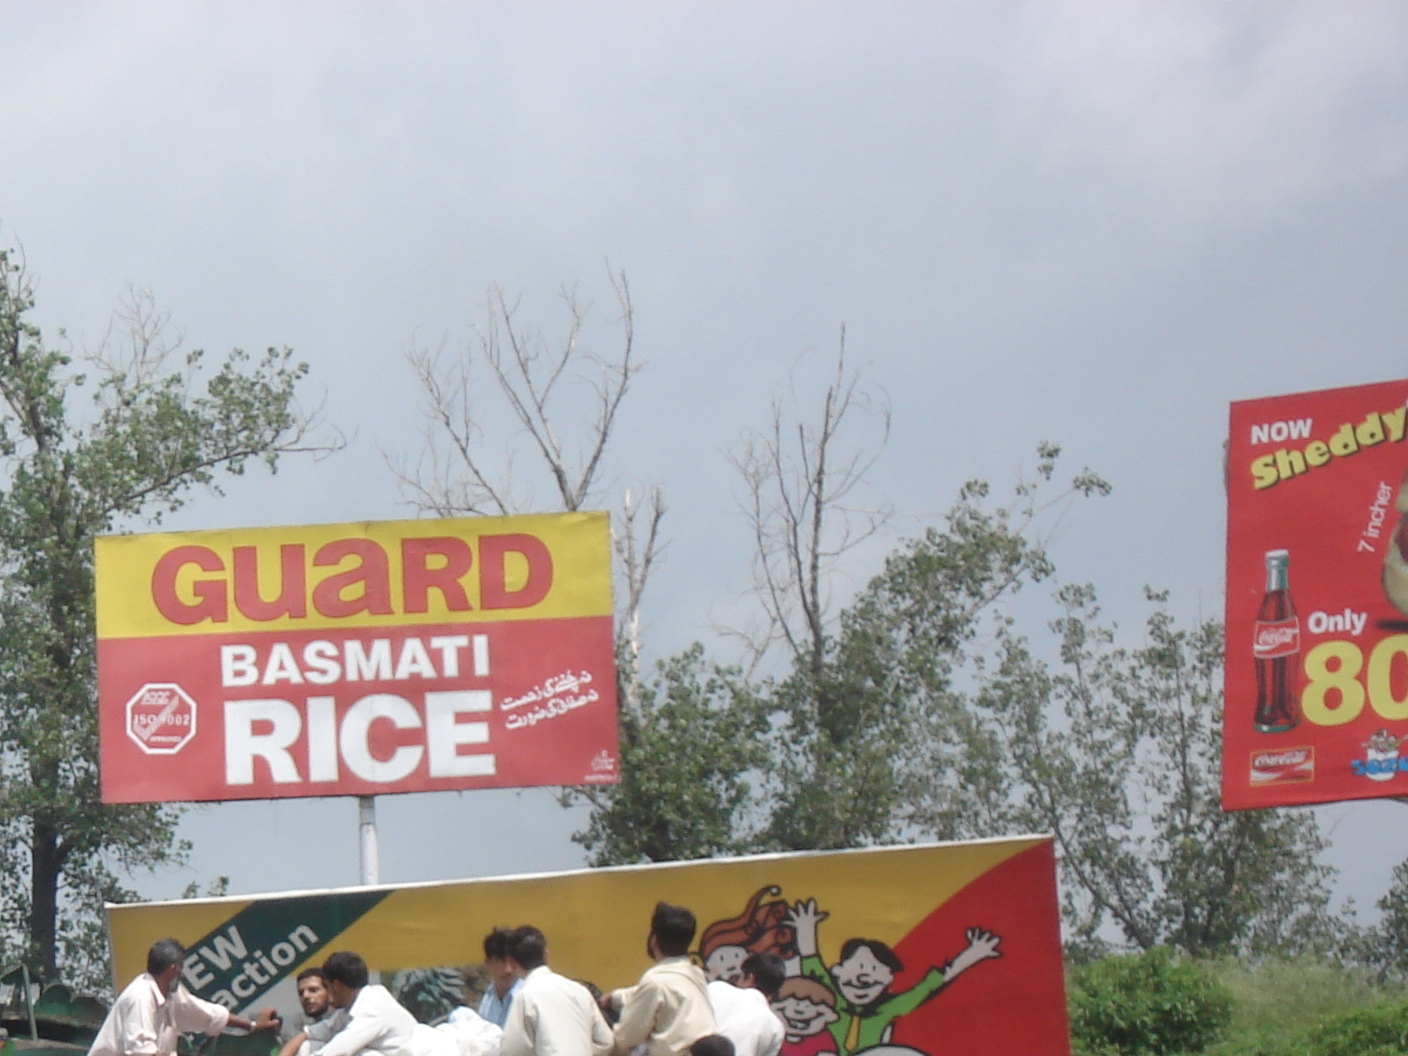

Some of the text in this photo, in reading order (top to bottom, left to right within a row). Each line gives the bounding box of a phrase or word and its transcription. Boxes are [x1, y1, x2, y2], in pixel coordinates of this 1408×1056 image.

[1250, 405, 1406, 491] Sheddy
[1251, 418, 1313, 445] NOW
[1356, 481, 1393, 553] 7 incher
[1308, 608, 1367, 636] Only
[220, 634, 490, 687] BASMATI
[1301, 634, 1408, 726] 80
[223, 690, 496, 785] RICE
[182, 924, 248, 990] EW
[210, 923, 321, 1009] action
